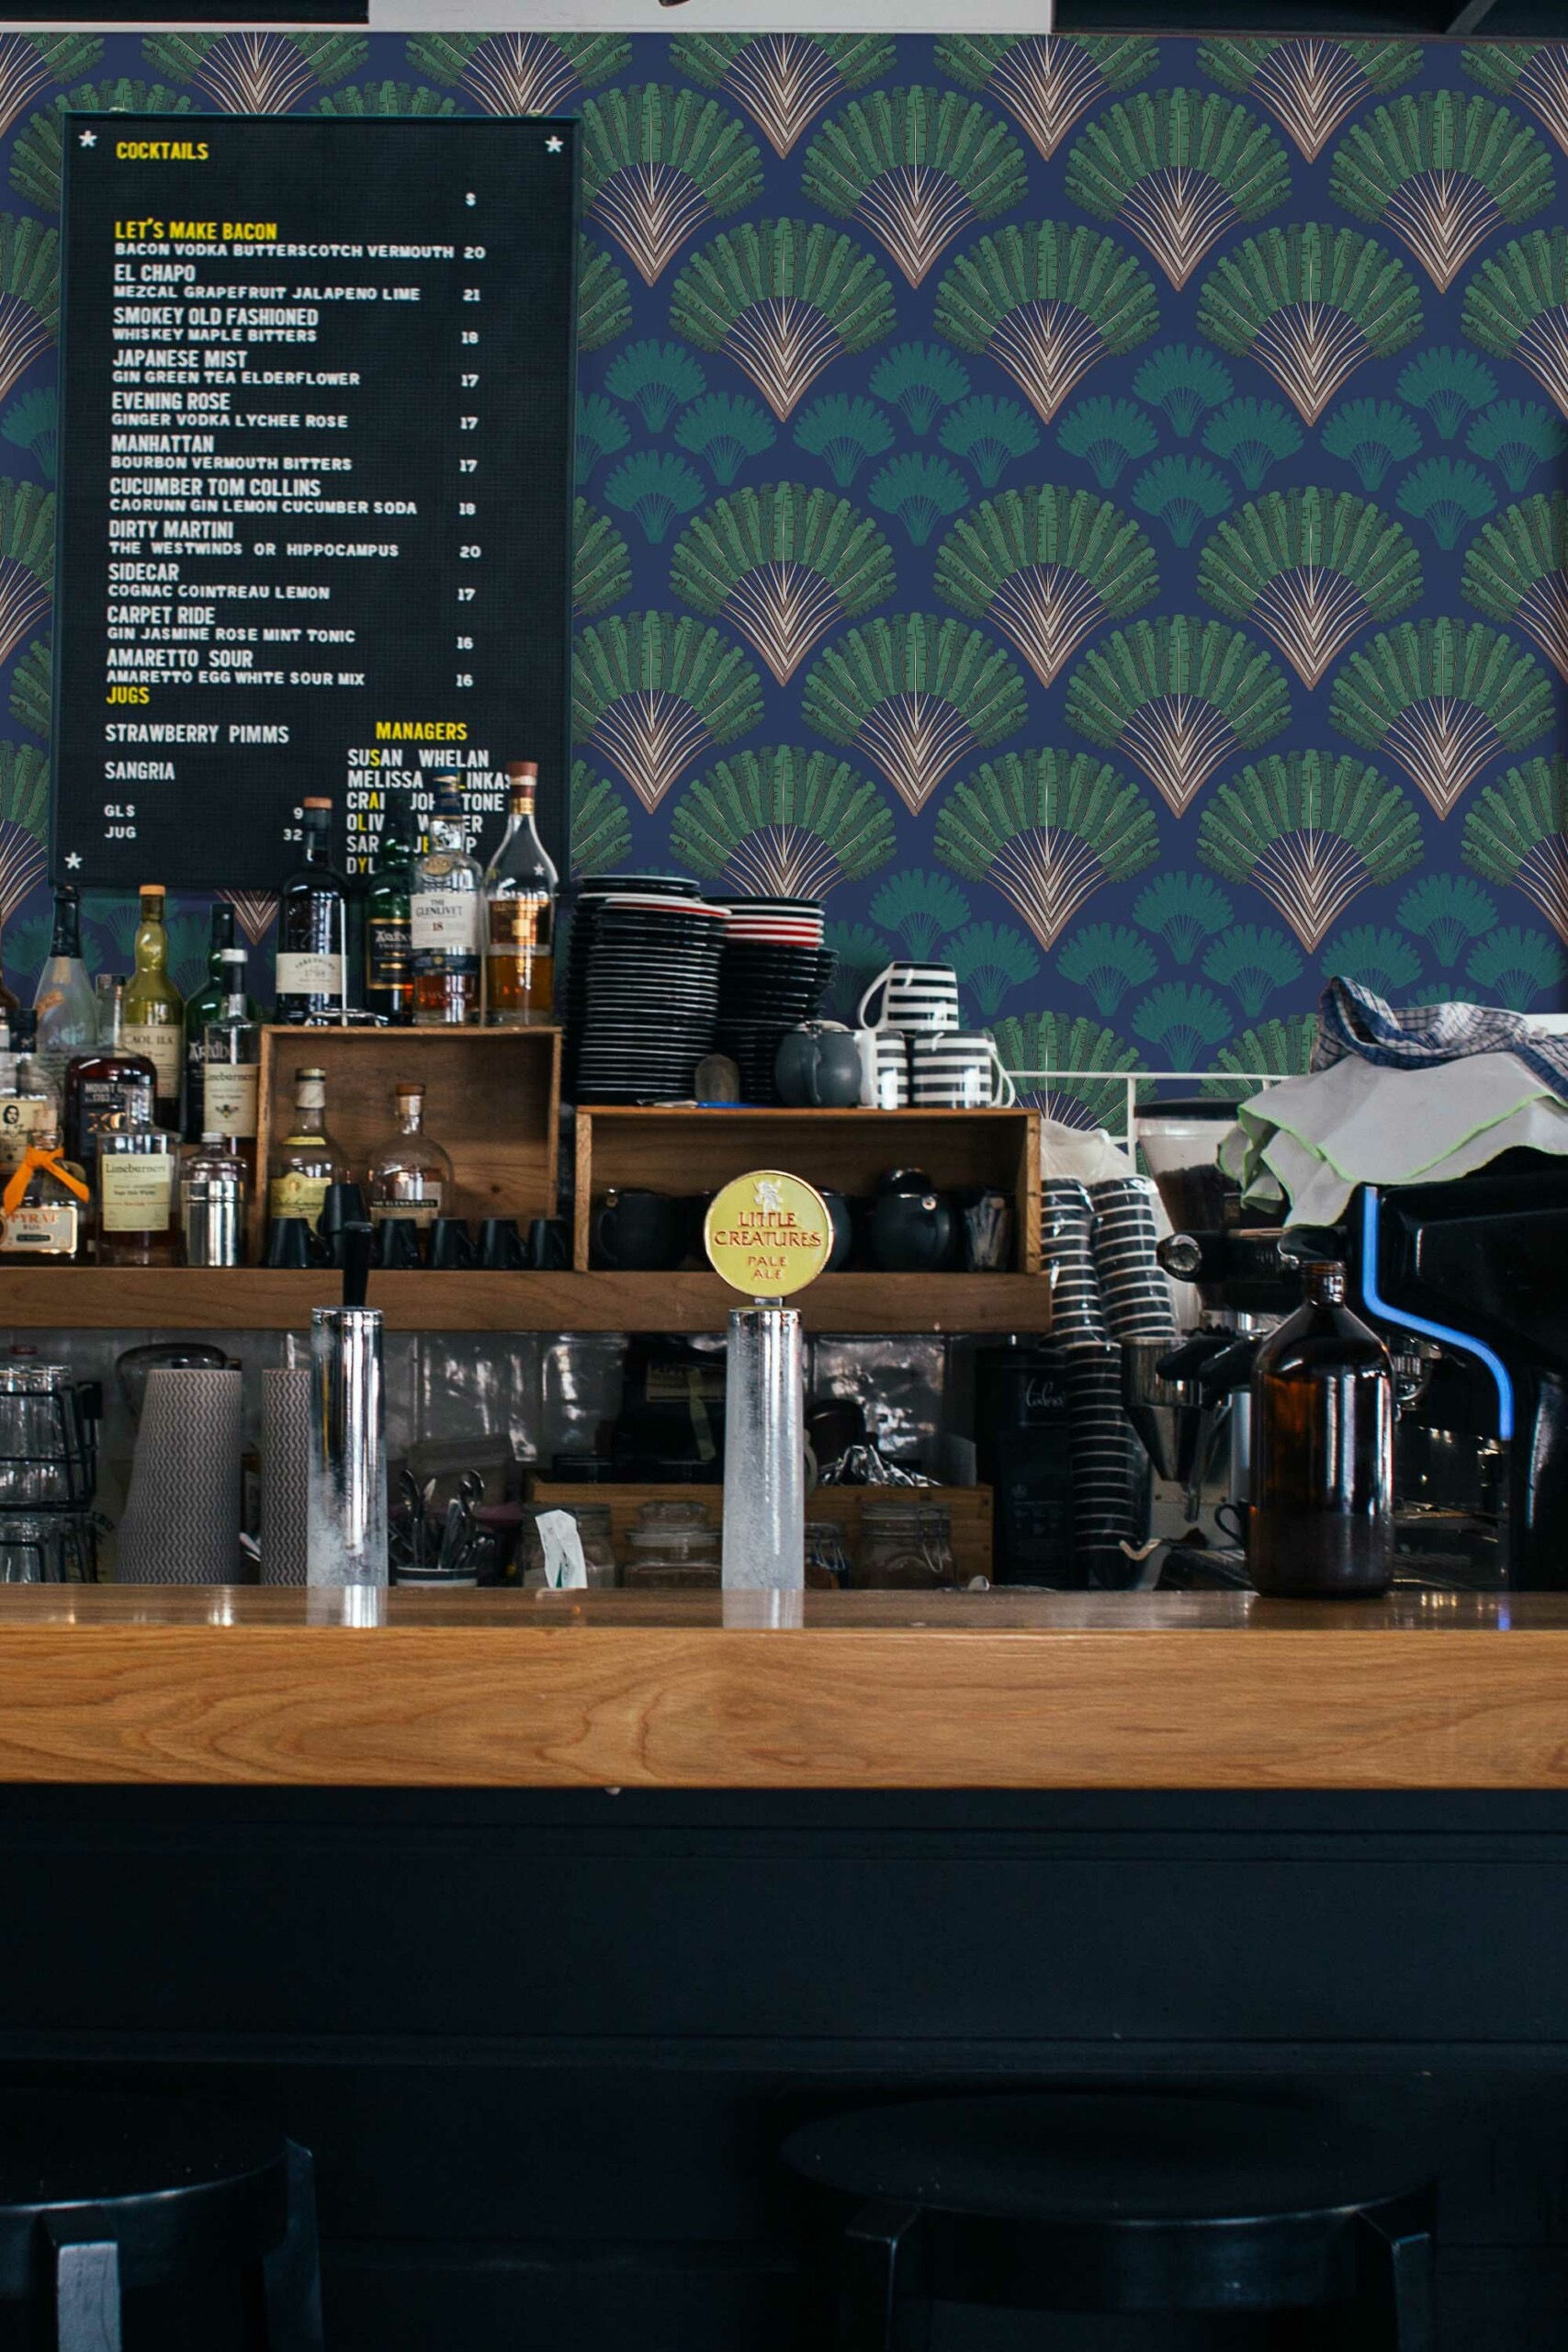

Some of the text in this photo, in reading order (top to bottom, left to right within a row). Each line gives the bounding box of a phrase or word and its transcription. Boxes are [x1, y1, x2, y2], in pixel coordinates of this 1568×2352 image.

[117, 142, 208, 160] COCKTAILS
[116, 218, 276, 240] LET'S MAKE BACON
[115, 243, 454, 258] BACON VODKA BUTTERSCOTCH VERMOUTH
[464, 246, 485, 259] 20
[115, 264, 196, 282] EL CHAPO
[114, 285, 420, 300] MEZCAL GRAPEFRUIT JALAPENO LIME
[463, 289, 480, 301] 21
[114, 307, 318, 326] SMOKEY OLD FASHIONED
[113, 328, 317, 342] WHISKEY MAPLE BITTERS
[462, 332, 479, 344] 18
[113, 349, 247, 368] JAPANESE MIST
[113, 370, 359, 385] GIN GREEN TEA ELDERFLOWER
[462, 374, 479, 387] 17
[112, 391, 231, 410] EVENING ROSE
[112, 413, 347, 427] GINGER VODKA LYCHEE ROSE
[461, 417, 478, 429] 17
[112, 435, 214, 453] MANHATTAN
[111, 456, 352, 470] BOURBON VERMOUTH BITTERS
[460, 459, 477, 472] 17
[110, 478, 321, 497] CUCUMBER TOM COLLINS
[110, 499, 417, 514] CAORUNN GIN LEMON CUCUMBER SODA
[459, 503, 476, 514] 18
[109, 520, 233, 538] DIRTY MARTINI
[109, 541, 399, 557] THE WESTWINDS OR HIPPOCAMPUS
[460, 546, 481, 558] 20
[108, 563, 179, 581] SIDECAR
[108, 584, 330, 599] COGNAC COINTREAU LEMON
[458, 588, 475, 601] 17
[107, 605, 215, 625] CARPET RIDE
[107, 627, 355, 642] GIN JASMINE ROSE MINT TONIC
[457, 637, 473, 650] 16
[107, 649, 253, 668] AMARETTO SOUR
[107, 670, 365, 685] AMARETTO EGG WHITE SOUR MIX
[457, 674, 473, 687] 16
[107, 686, 149, 704] JUGS
[106, 724, 288, 743] STRAWBERRY PIMMS
[377, 722, 467, 740] MANAGERS
[348, 749, 489, 768] SUSAN WHELAN
[106, 762, 175, 780] SANGRIA
[348, 770, 423, 788] MELISSA
[346, 791, 386, 810] CRAI
[105, 805, 135, 817] GLS
[294, 808, 303, 819] 9
[346, 813, 385, 831] OLIV
[105, 826, 136, 838] JUG
[284, 829, 302, 841] 32
[346, 835, 379, 853] SAR
[346, 856, 376, 875] DYL
[416, 906, 463, 917] GLENLIVET
[739, 1212, 796, 1227] LITTLE
[715, 1231, 822, 1248] CREATURES
[748, 1255, 787, 1267] PALE
[753, 1269, 783, 1279] ALE
